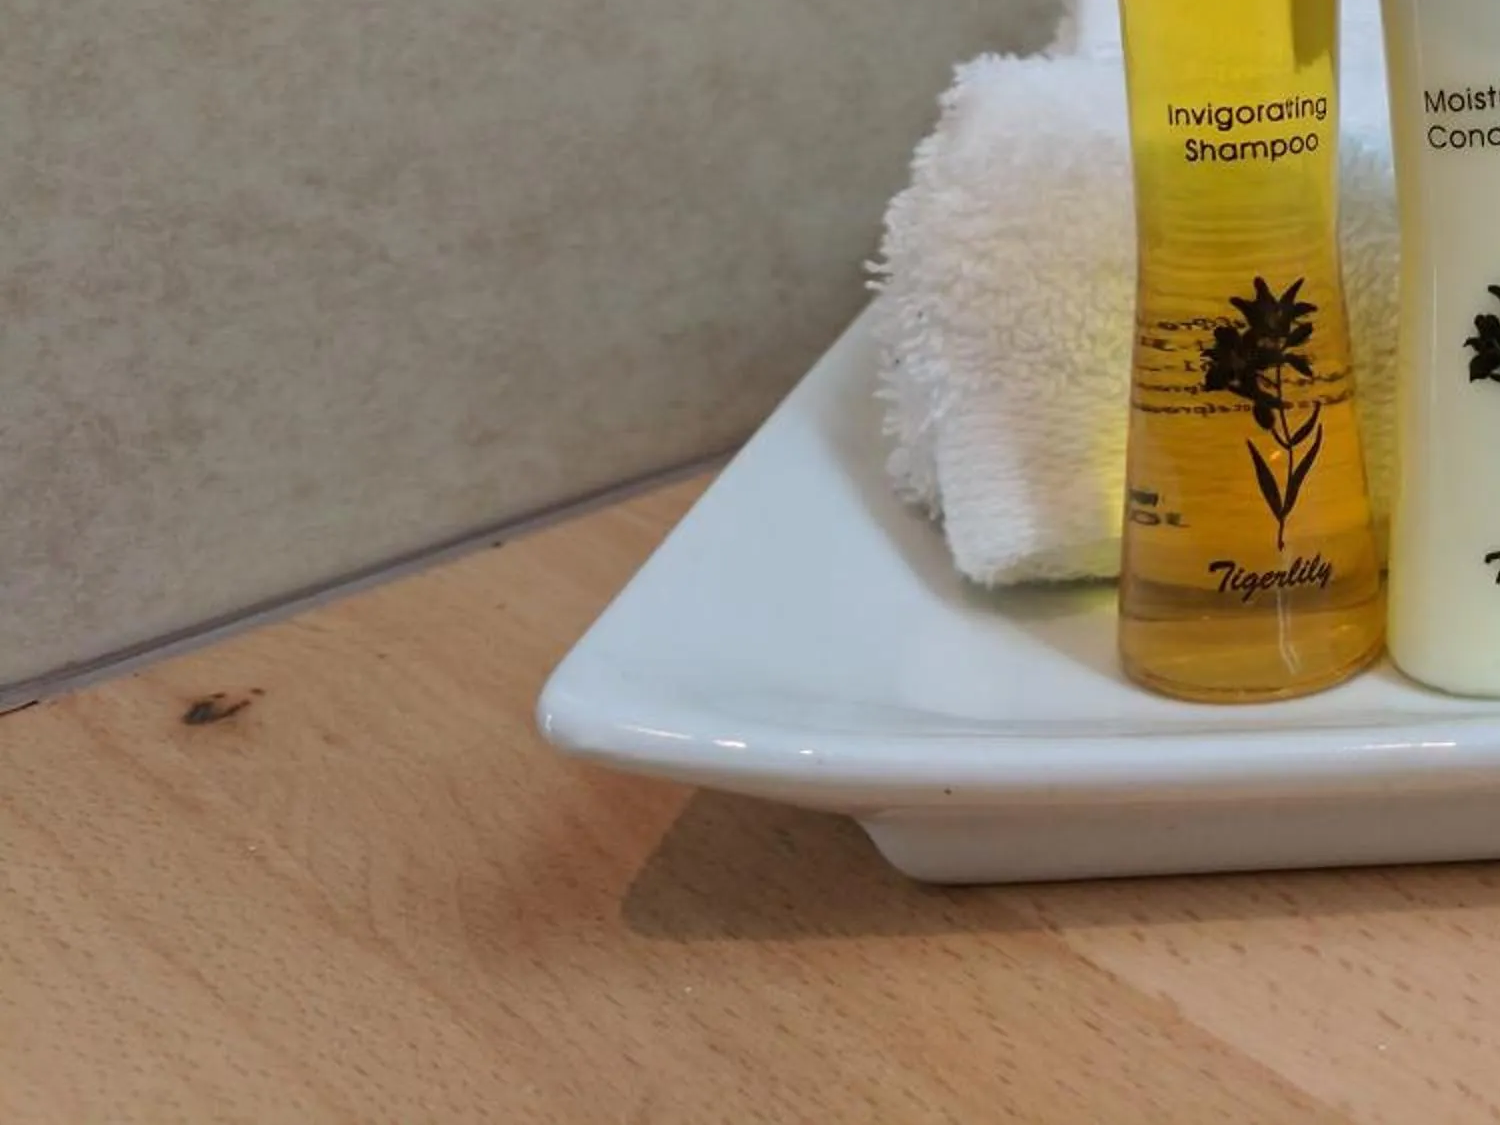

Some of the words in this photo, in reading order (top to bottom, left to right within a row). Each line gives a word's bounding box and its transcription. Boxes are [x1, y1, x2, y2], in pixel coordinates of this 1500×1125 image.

[1167, 93, 1329, 133] Invigorating
[1184, 131, 1321, 163] Shampoo
[1207, 554, 1335, 603] Tigerlily
